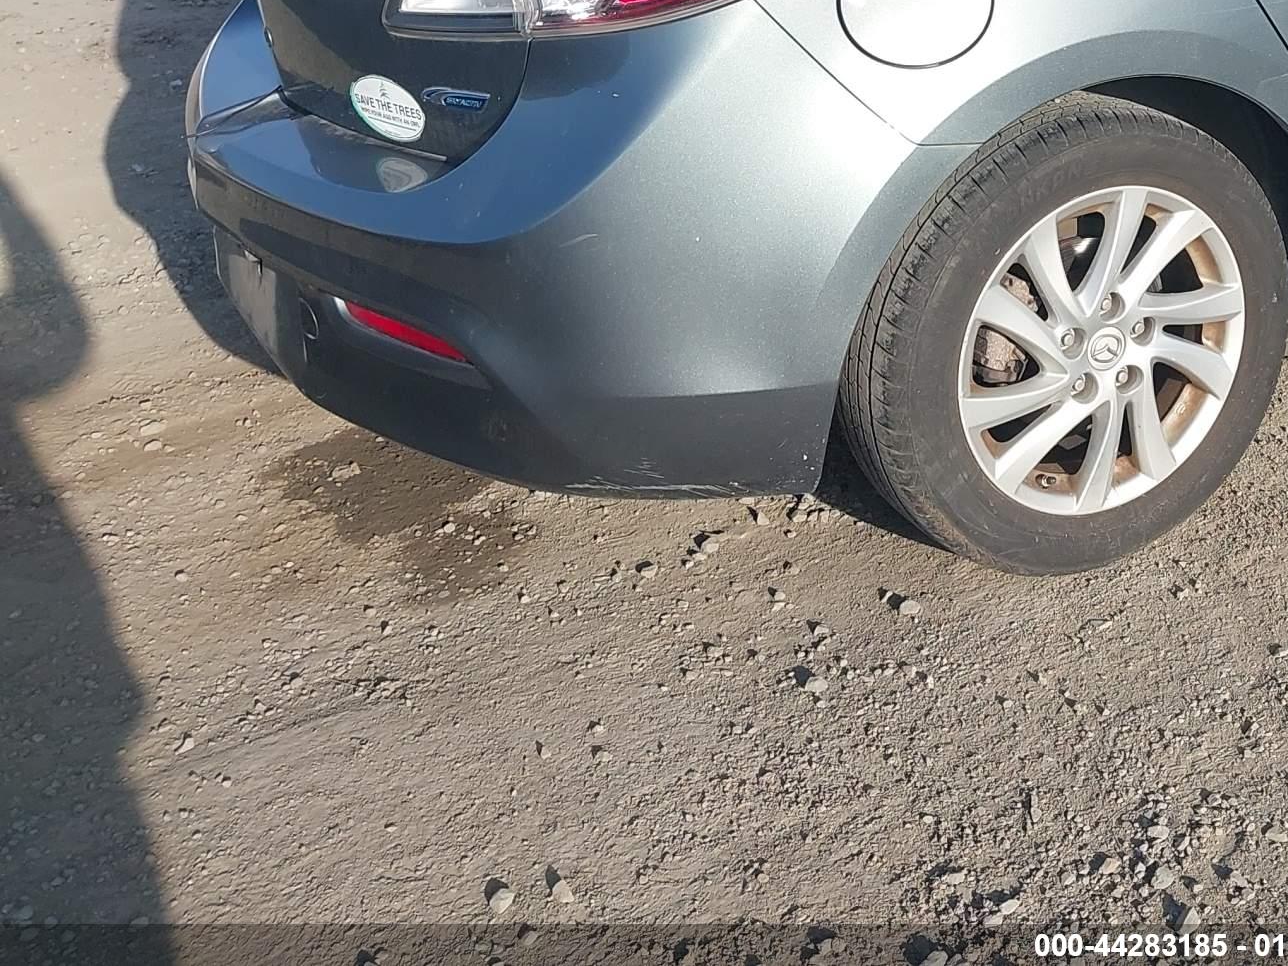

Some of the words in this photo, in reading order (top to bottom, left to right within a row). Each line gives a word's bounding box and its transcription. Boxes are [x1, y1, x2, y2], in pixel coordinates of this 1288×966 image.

[354, 93, 376, 108] SAVE
[375, 98, 393, 114] THE
[392, 102, 422, 121] TREES
